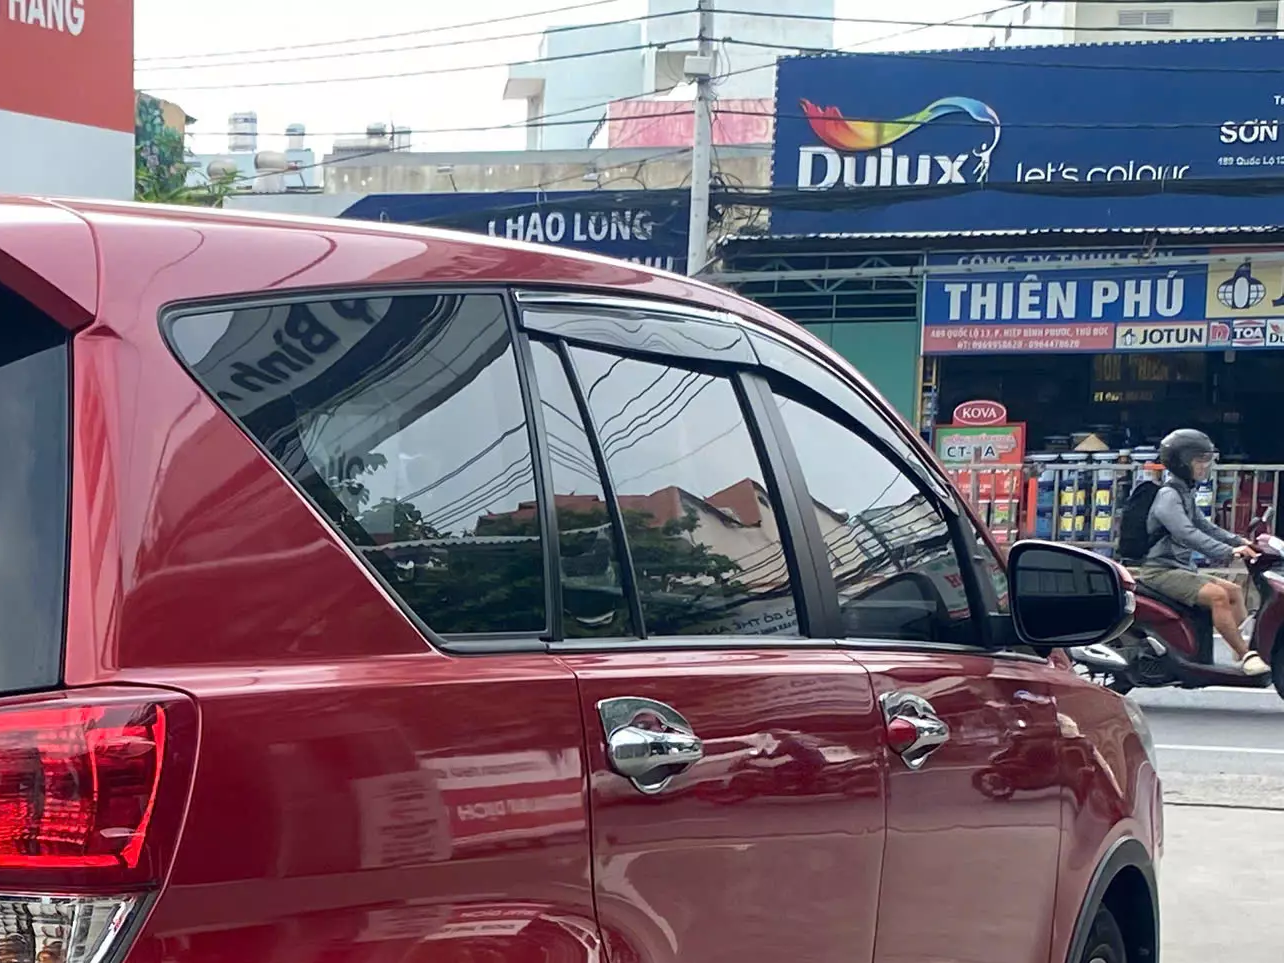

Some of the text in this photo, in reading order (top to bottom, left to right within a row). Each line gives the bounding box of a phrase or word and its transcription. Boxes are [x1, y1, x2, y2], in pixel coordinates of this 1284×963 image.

[1220, 118, 1278, 144] SƠN
[798, 147, 970, 192] Dulux
[944, 270, 1184, 320] THIÊN PHÚ
[1139, 328, 1203, 345] JOTUN
[1232, 327, 1264, 339] TOA
[962, 407, 998, 419] KOVA
